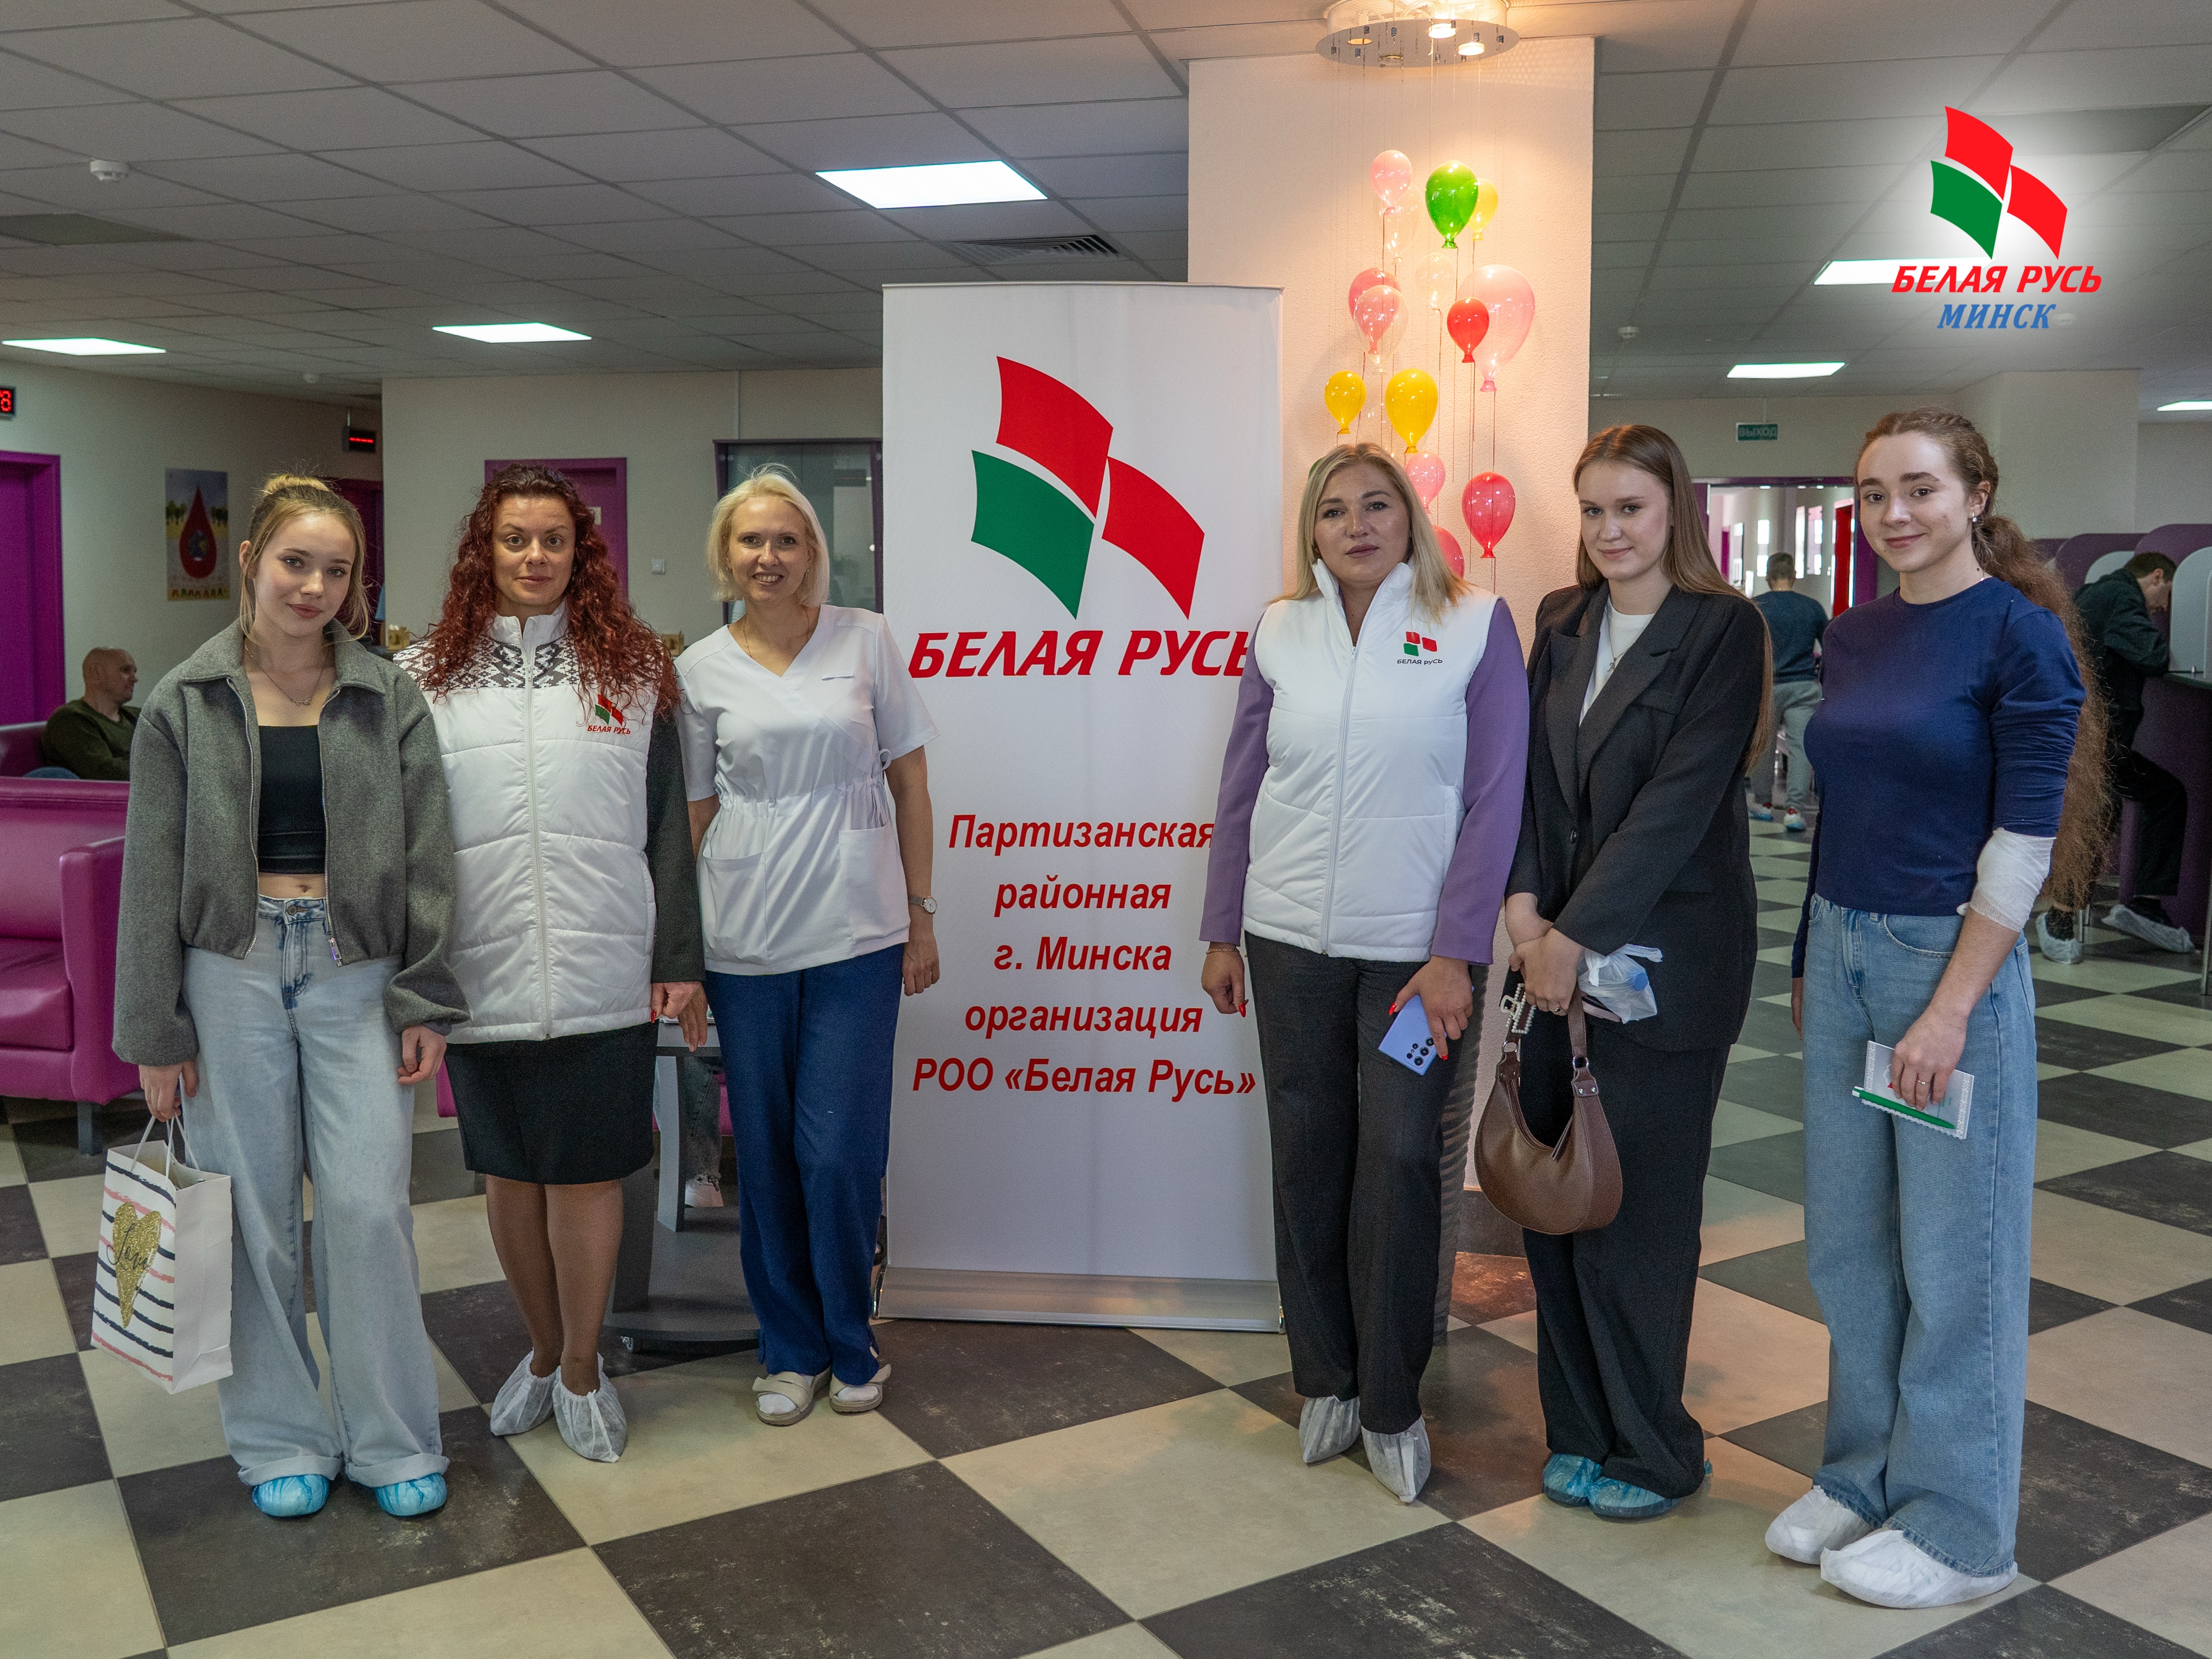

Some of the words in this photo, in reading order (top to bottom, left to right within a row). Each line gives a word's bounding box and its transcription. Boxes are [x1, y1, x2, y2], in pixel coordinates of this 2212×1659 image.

[1739, 426, 1777, 437] ВЫХОД
[908, 630, 1104, 678] БЕЛАЯ
[948, 814, 1215, 857] Партизанская
[994, 875, 1172, 918] районная
[994, 944, 1023, 970] г.
[1036, 936, 1172, 971] Минска
[965, 1006, 1203, 1039] организация
[913, 1057, 993, 1091] РОО
[1005, 1058, 1136, 1092] «Белая
[1148, 1059, 1256, 1102] Русь»
[106, 1223, 149, 1271] Love
